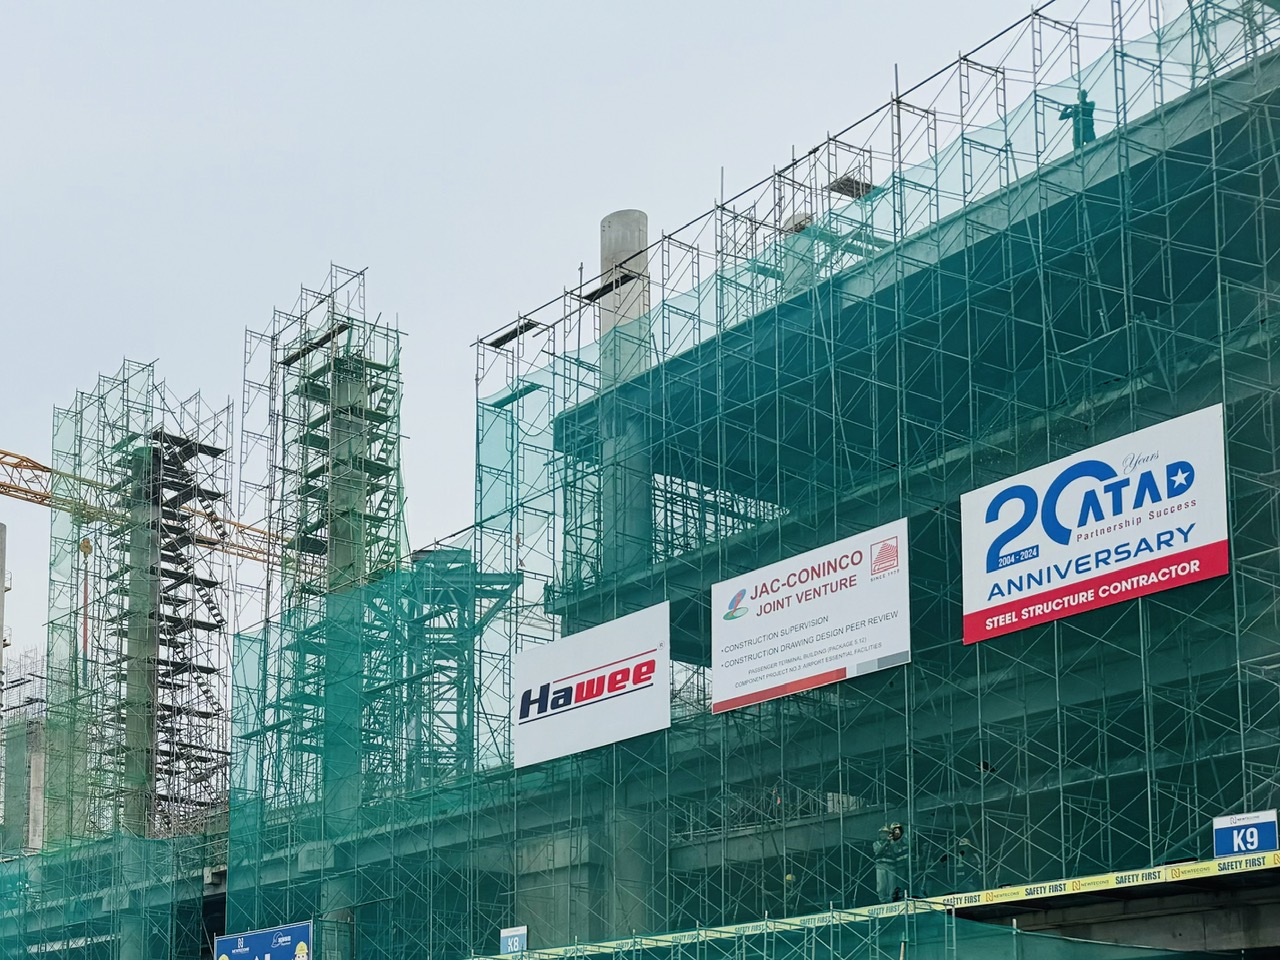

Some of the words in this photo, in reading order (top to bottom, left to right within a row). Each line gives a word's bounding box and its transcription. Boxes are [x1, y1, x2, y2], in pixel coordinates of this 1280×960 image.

[1122, 450, 1159, 475] Years
[1077, 515, 1142, 543] Partnership
[1148, 499, 1197, 520] Success
[750, 550, 863, 600] JAC-CONINCO
[987, 523, 1196, 601] ANNIVERSARY
[998, 555, 1015, 567] 2004
[1020, 548, 1037, 561] 2024
[756, 595, 792, 617] JOINT
[795, 574, 858, 604] VENTURE
[985, 612, 1018, 631] STEEL
[1021, 590, 1095, 621] STRUCTURE
[1098, 560, 1200, 598] CONTRACTOR
[724, 632, 779, 653] CONSTRUCTION
[780, 615, 829, 637] SUPERVISION
[724, 647, 779, 668] CONSTRUCTION
[780, 635, 814, 652] DRAWING
[815, 627, 844, 642] DESIGN
[845, 620, 866, 633] PEER
[868, 610, 899, 626] REVIEW
[519, 659, 656, 720] Hawee
[1233, 827, 1258, 852] K9
[964, 894, 981, 903] FIRST
[1025, 885, 1047, 896] SAFETY
[1049, 883, 1067, 893] FIRST
[1115, 873, 1140, 885] SAFETY
[1141, 870, 1161, 881] FIRST
[1217, 860, 1243, 872] SAFETY
[1245, 856, 1266, 867] FIRST
[507, 936, 519, 952] K8
